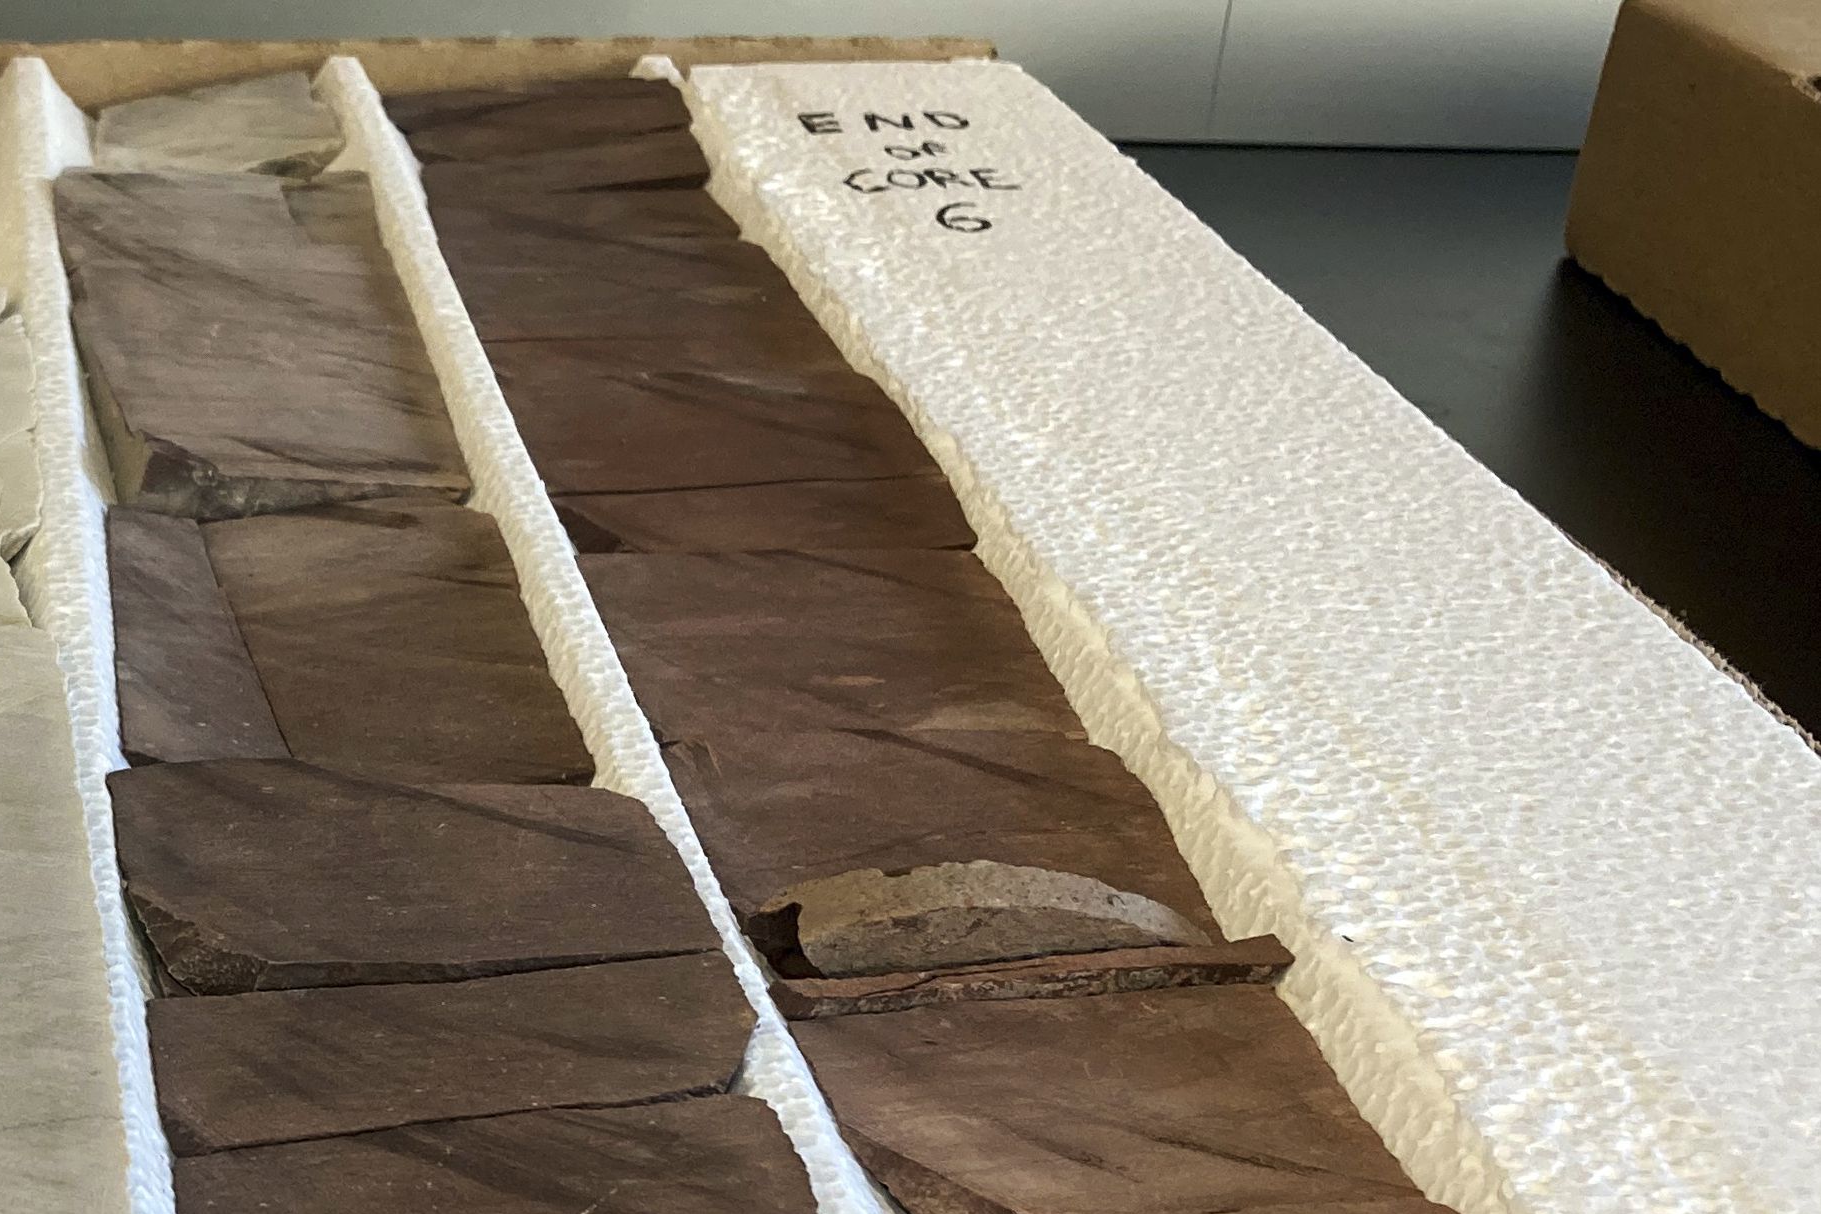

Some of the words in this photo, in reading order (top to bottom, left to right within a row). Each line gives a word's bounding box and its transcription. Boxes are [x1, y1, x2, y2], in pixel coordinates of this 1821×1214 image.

[797, 110, 970, 135] END
[842, 168, 1023, 194] CORE
[935, 201, 993, 233] 6
